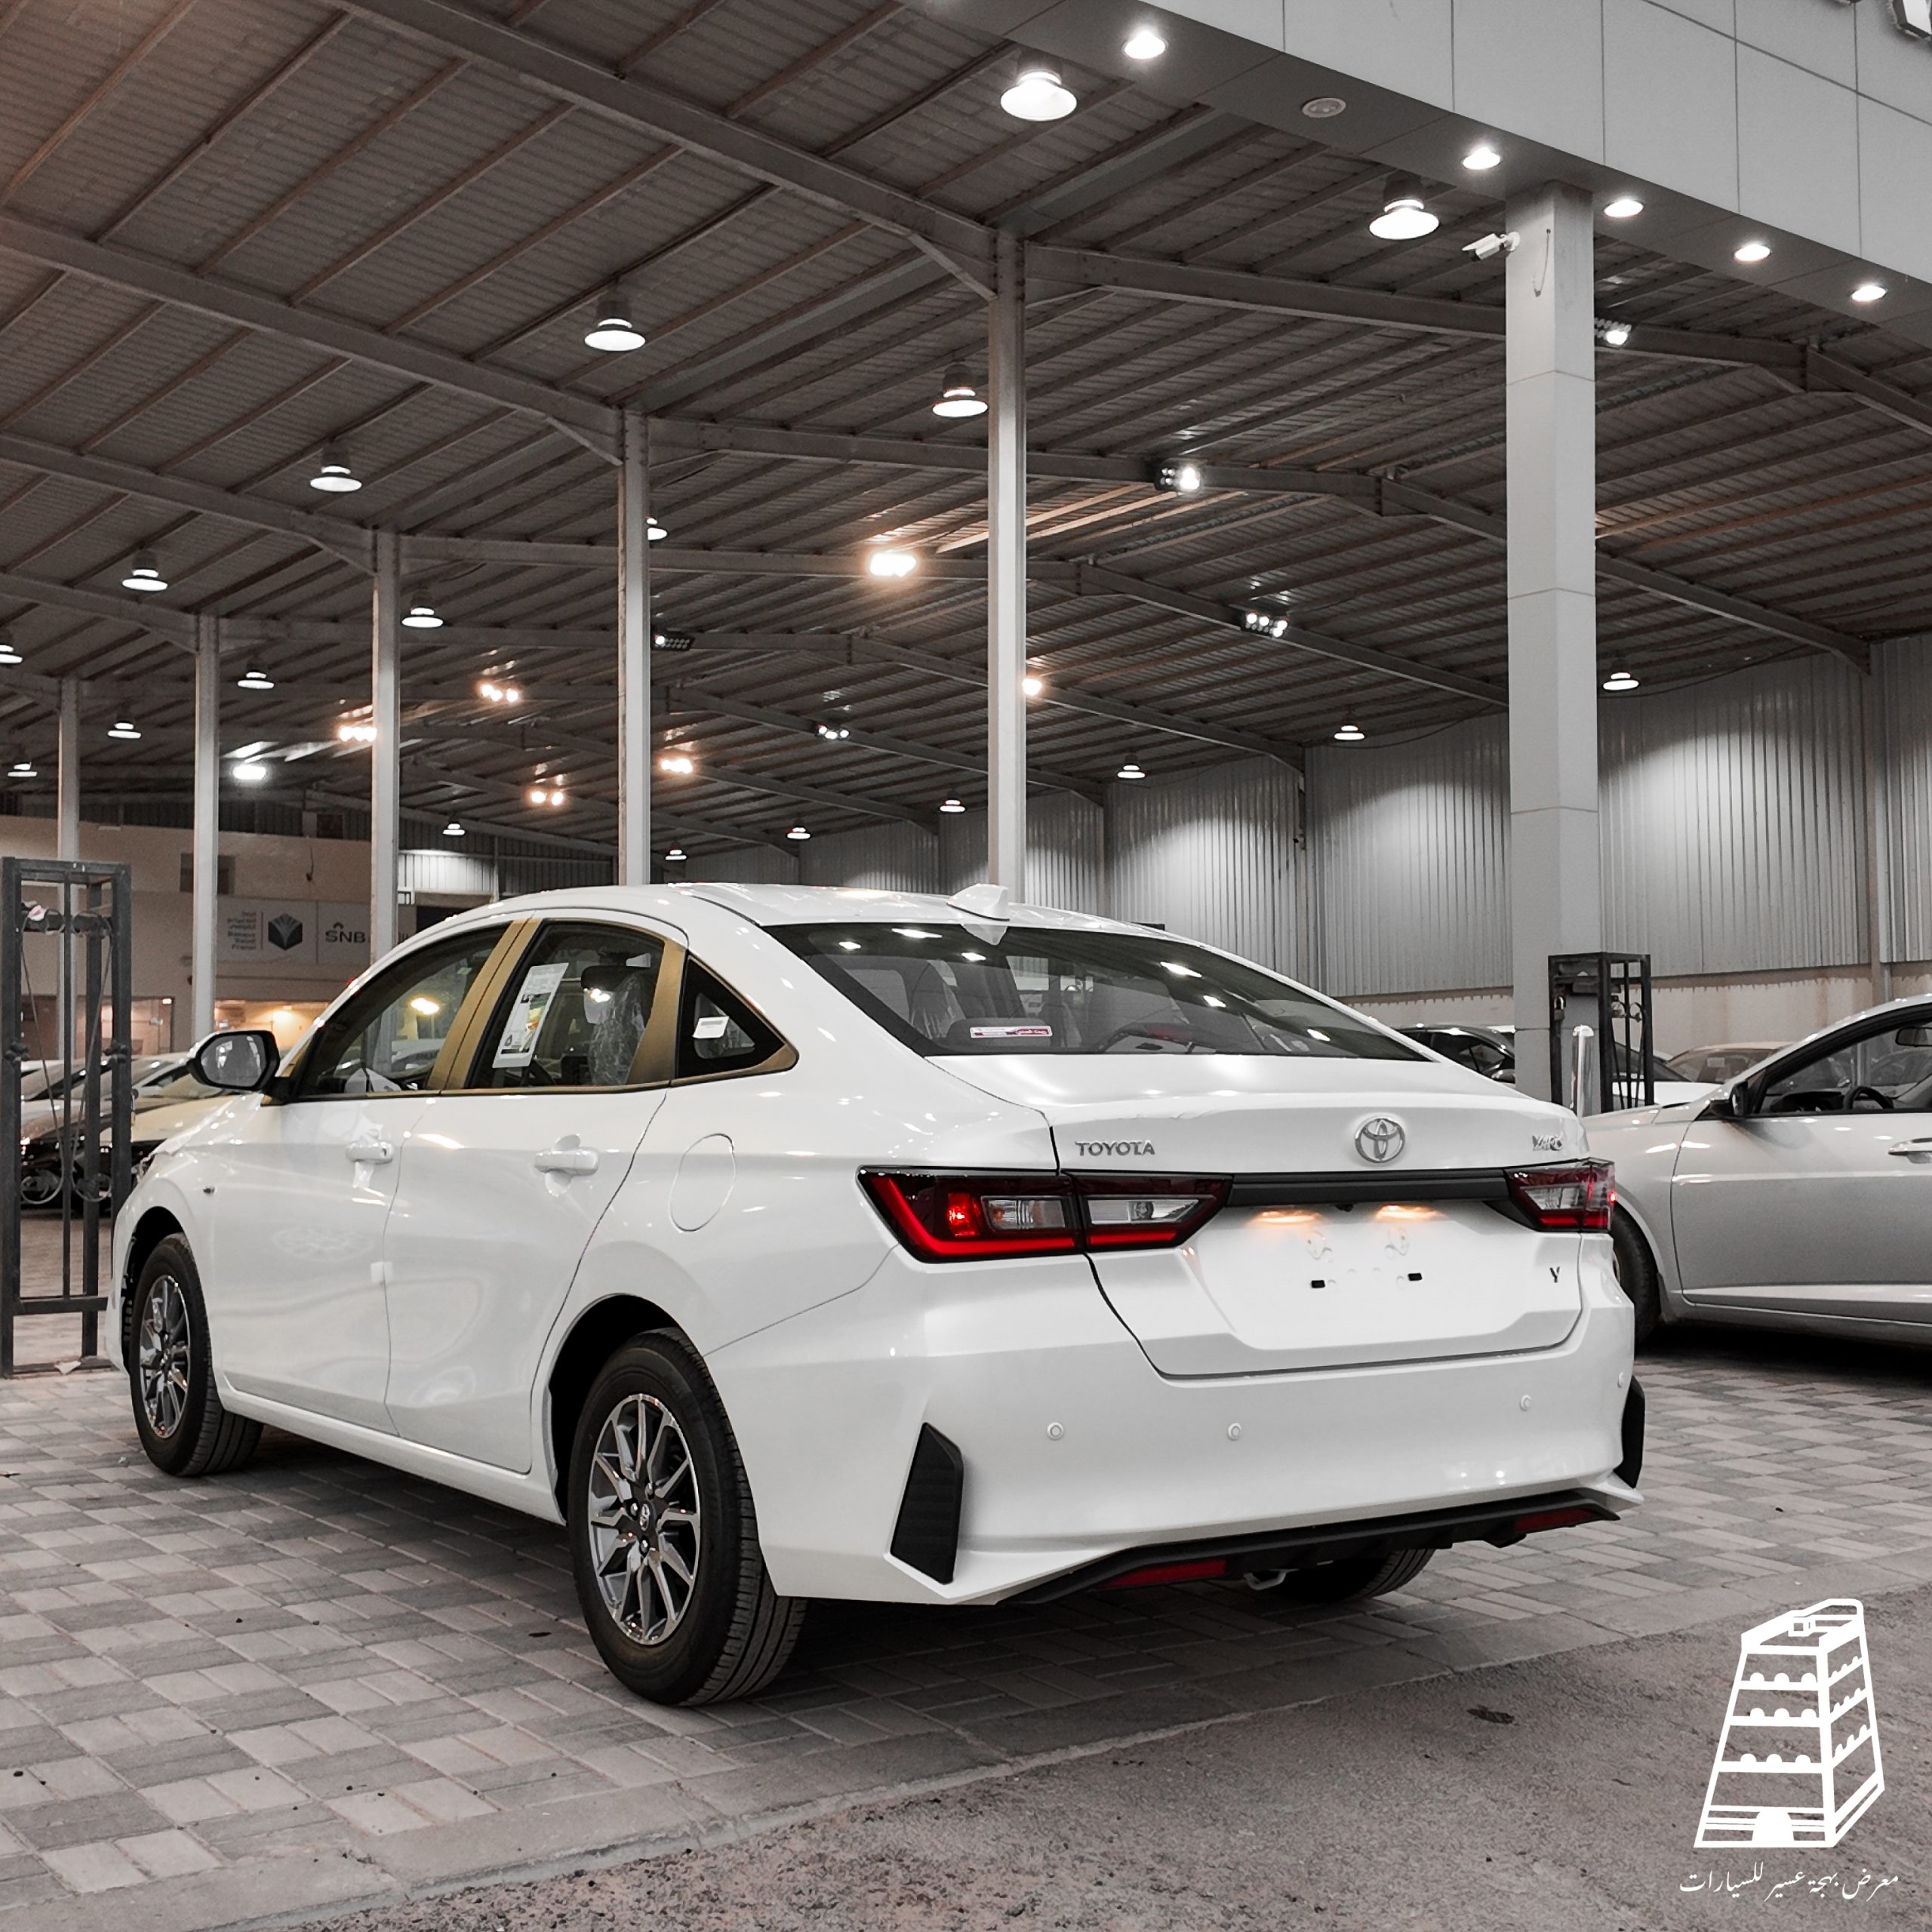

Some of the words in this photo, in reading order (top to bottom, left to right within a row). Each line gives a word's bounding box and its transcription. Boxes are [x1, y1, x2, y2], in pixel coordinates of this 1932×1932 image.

[325, 929, 367, 944] SNB
[1074, 1140, 1155, 1156] TOYOTA
[1549, 1266, 1561, 1284] Y
